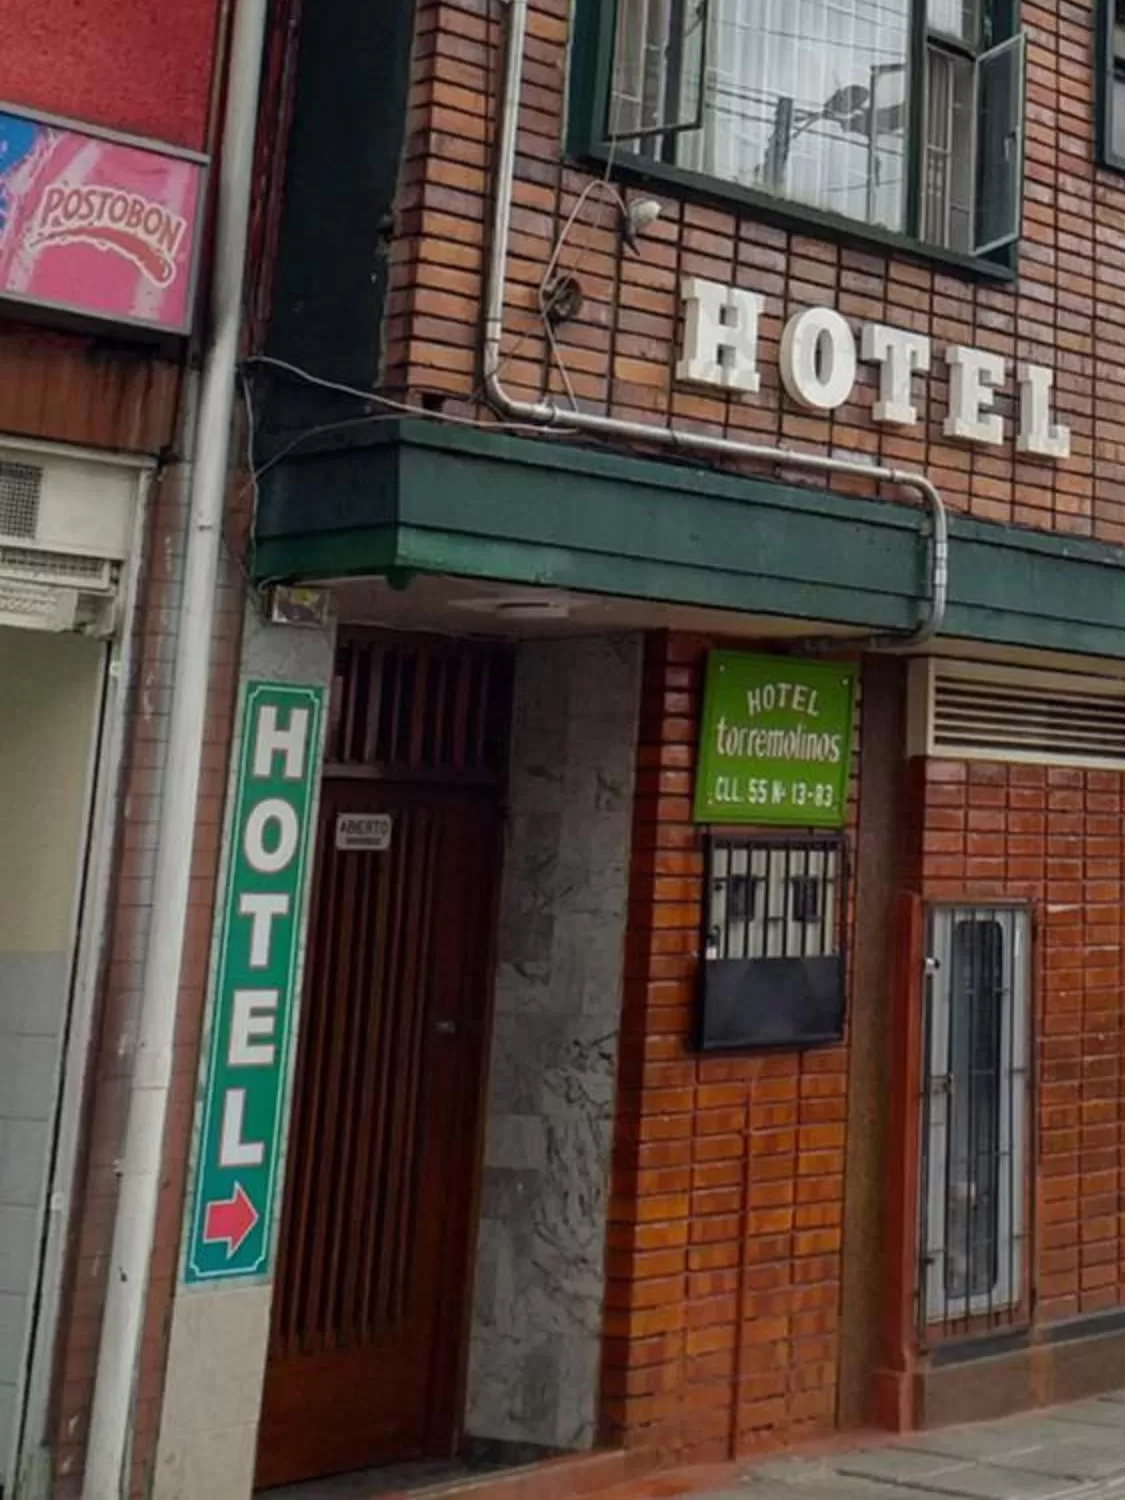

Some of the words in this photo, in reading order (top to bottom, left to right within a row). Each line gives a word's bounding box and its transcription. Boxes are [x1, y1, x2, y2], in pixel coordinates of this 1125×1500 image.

[40, 187, 184, 249] POSTOBON
[676, 278, 1070, 458] HOTEL
[747, 682, 819, 716] HOTEL
[716, 716, 840, 763] torremolinos
[748, 778, 768, 804] 55
[218, 704, 309, 1167] HOTEL
